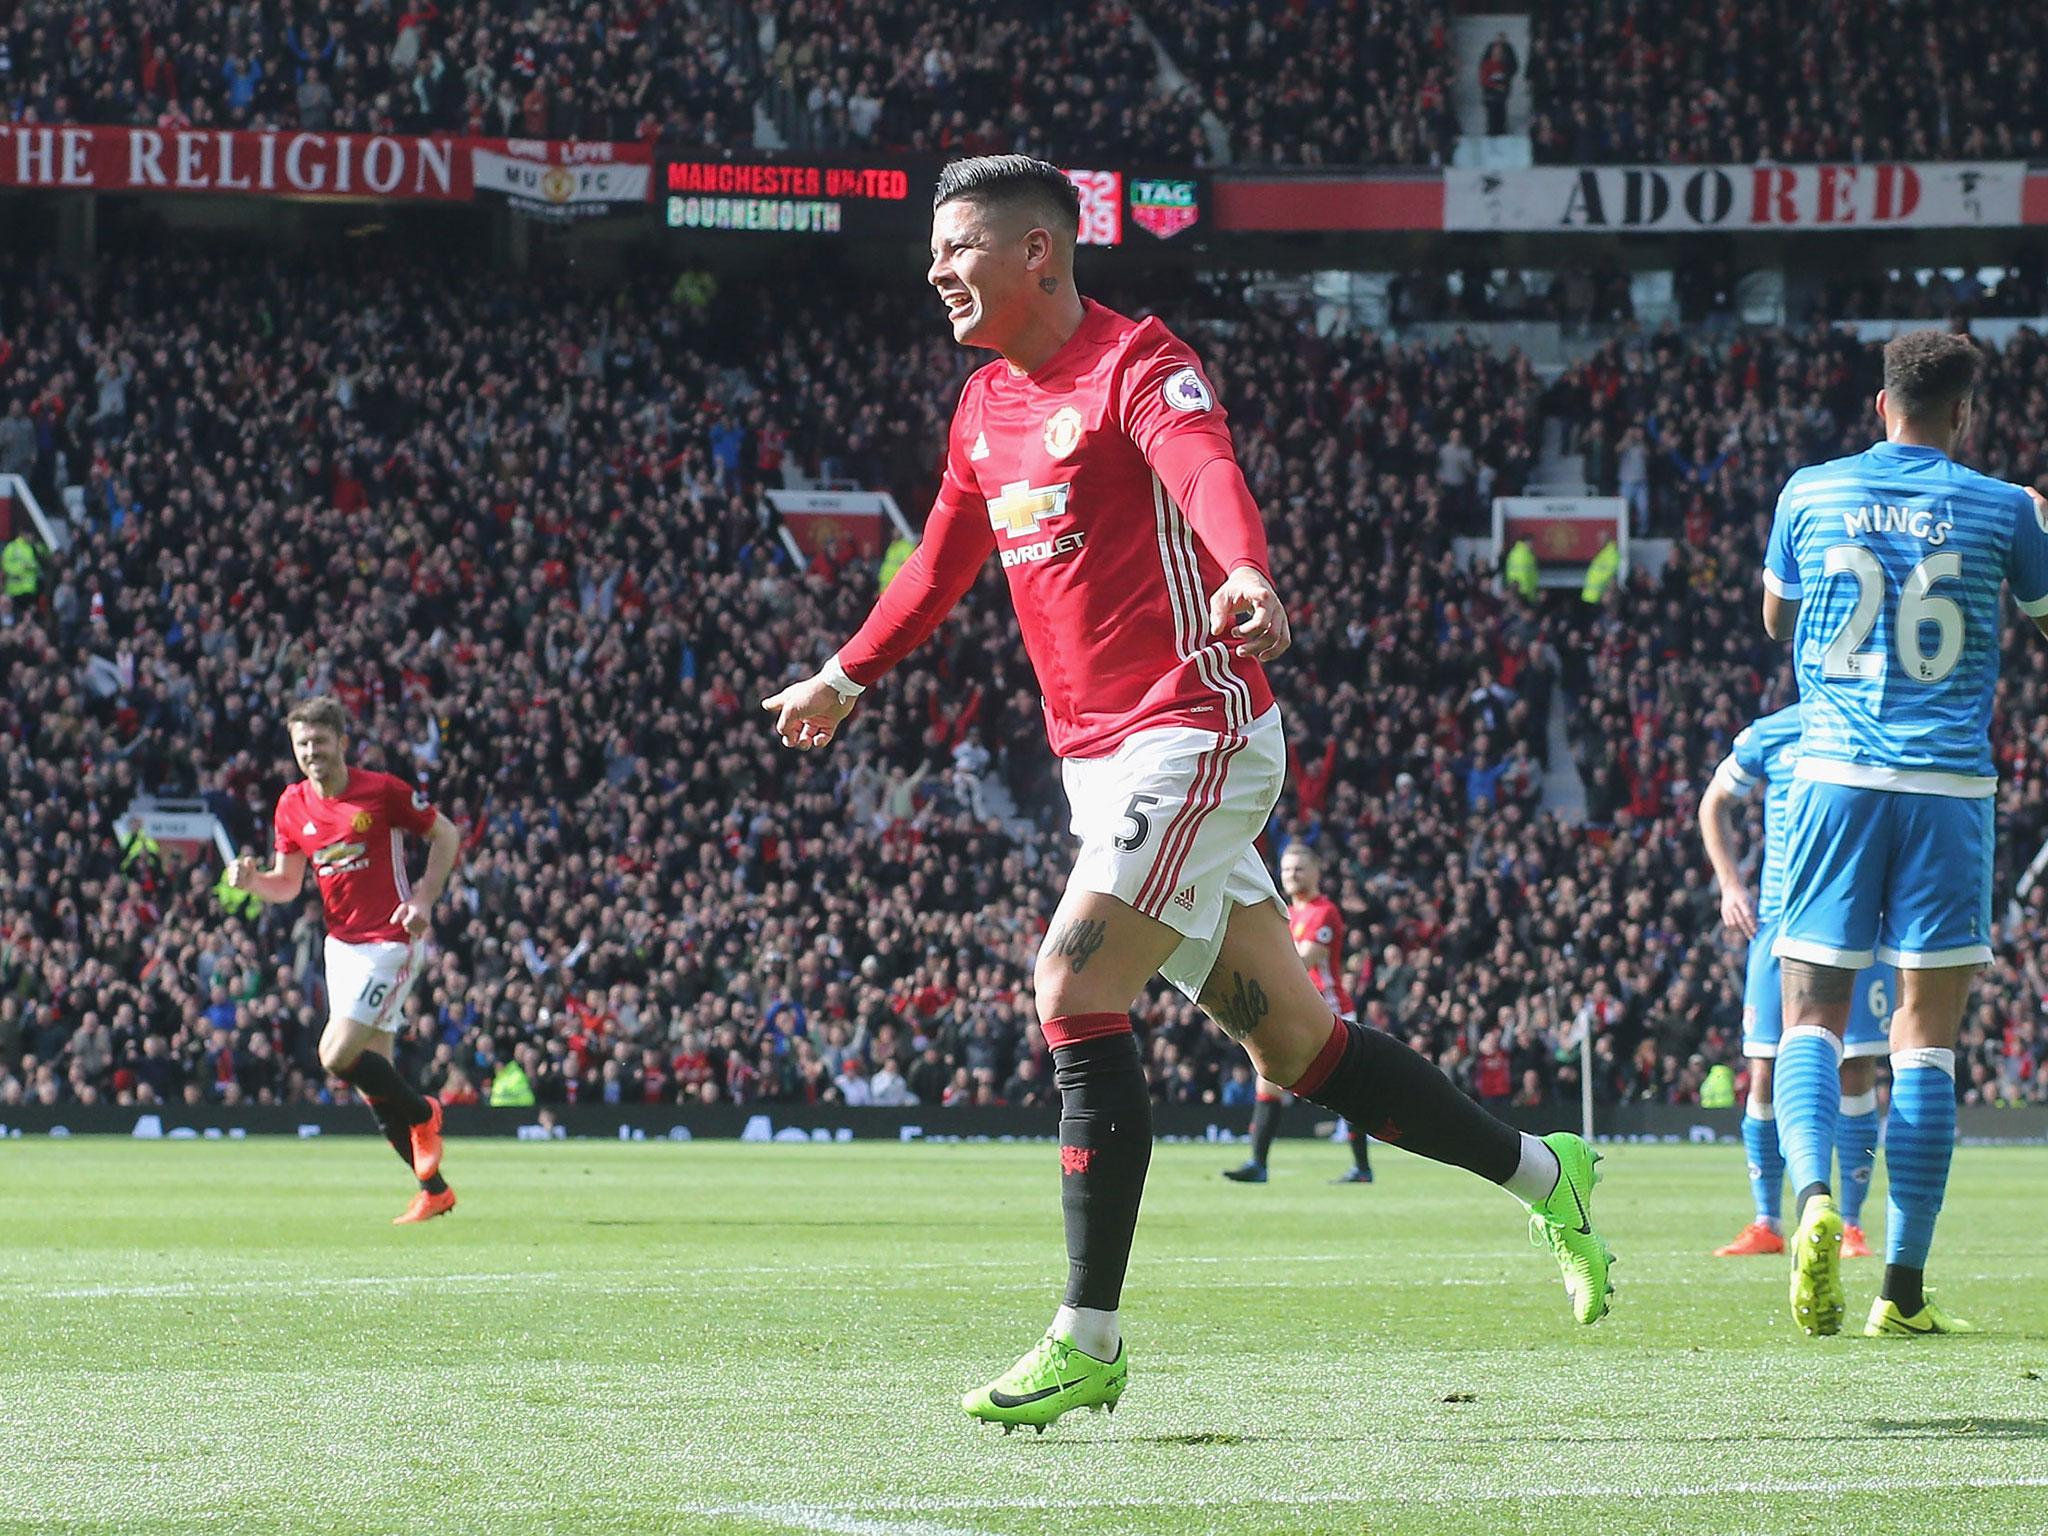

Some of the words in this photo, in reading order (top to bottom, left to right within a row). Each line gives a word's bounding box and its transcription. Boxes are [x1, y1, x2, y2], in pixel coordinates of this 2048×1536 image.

[128, 128, 452, 194] RELIGION
[667, 162, 820, 196] MANCHESTER
[825, 169, 909, 200] UNITED
[667, 195, 842, 232] BOURNEMOUTH
[1139, 182, 1193, 205] TAG
[1560, 163, 1921, 226] ADORED
[1842, 503, 1954, 547] MINGS
[1822, 543, 1966, 686] 26
[1112, 793, 1162, 854] 5
[359, 977, 388, 1009] 16
[1868, 978, 1889, 1019] 6
